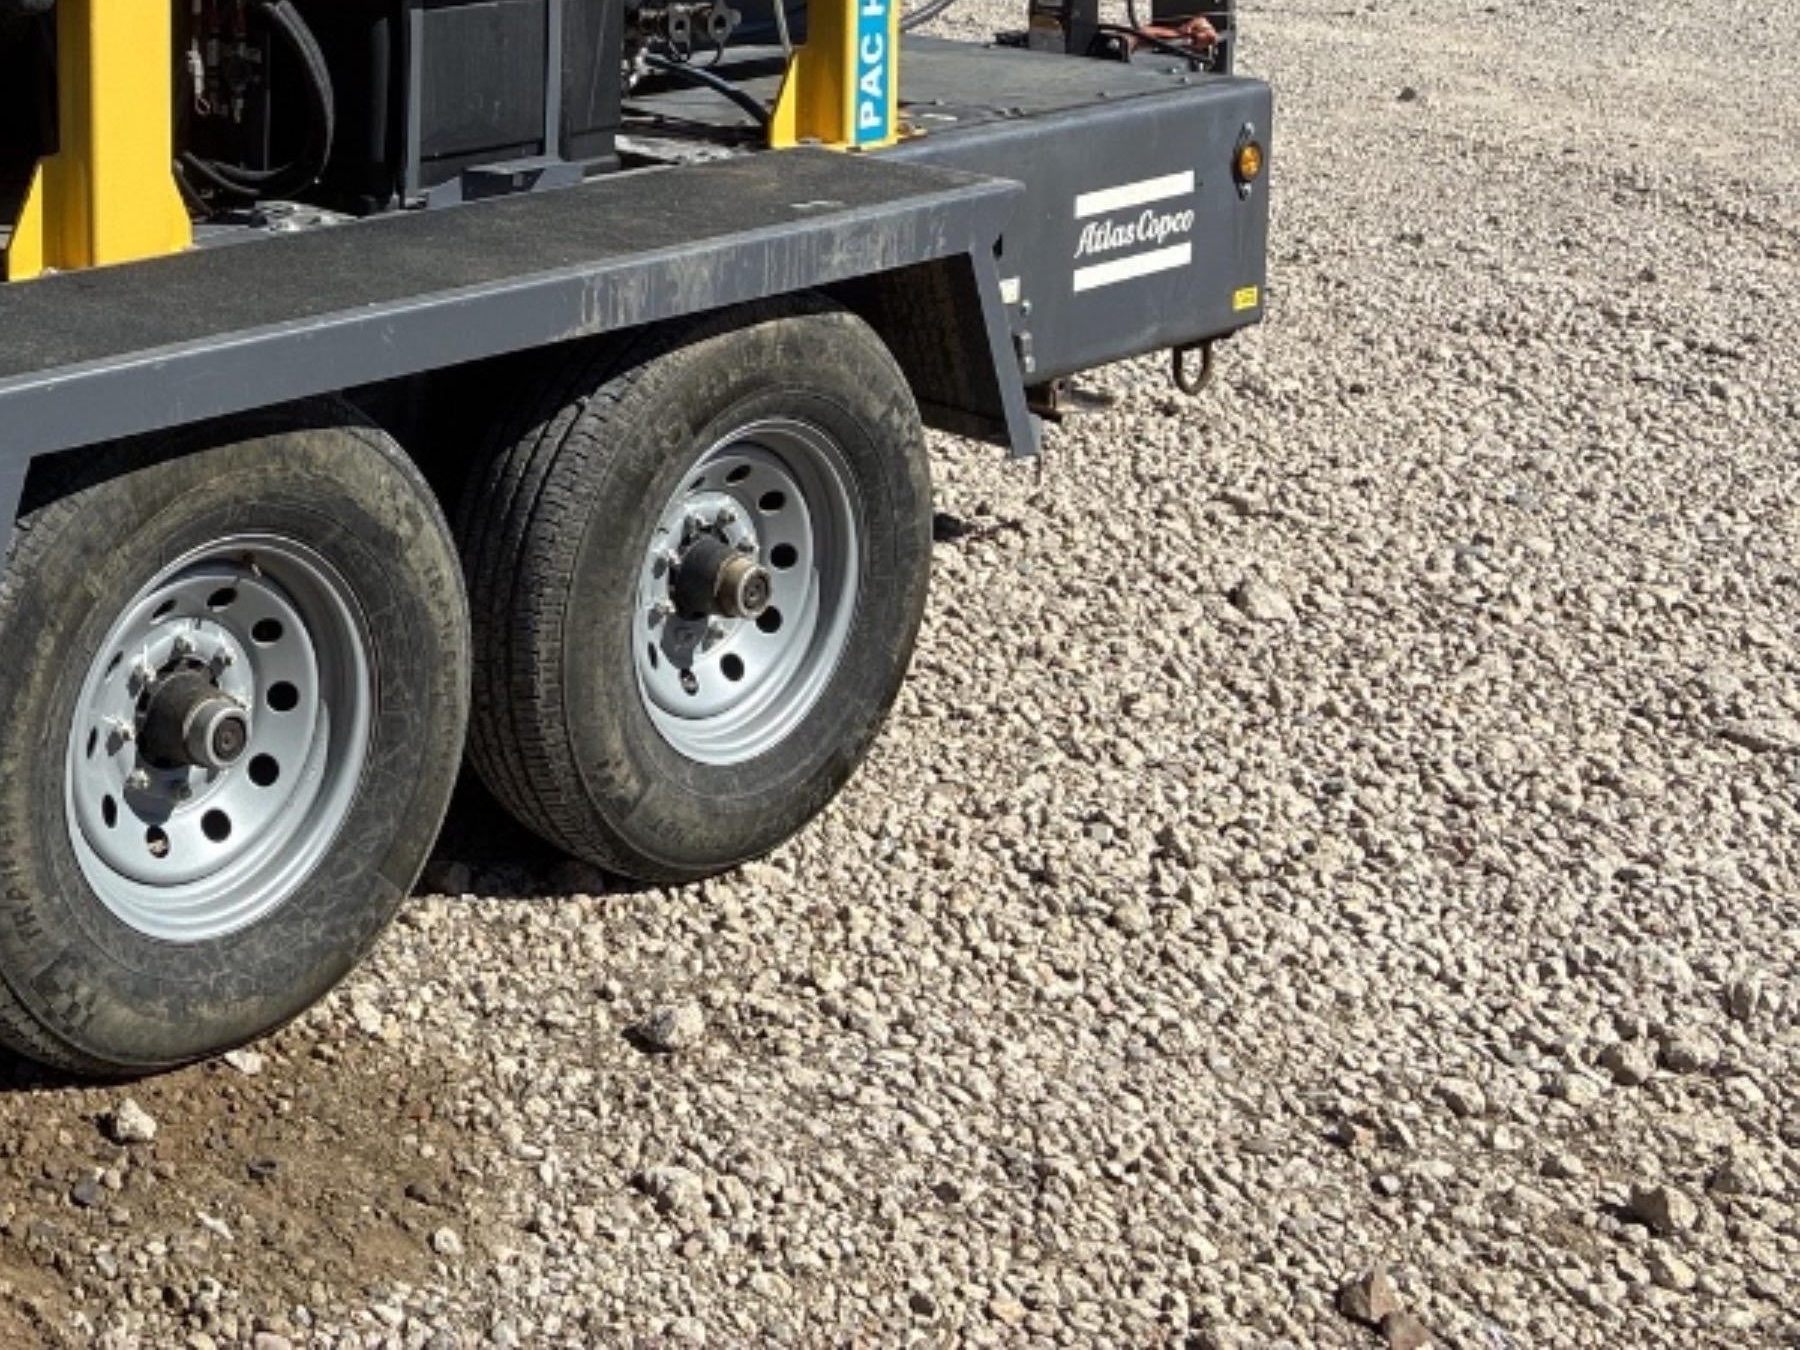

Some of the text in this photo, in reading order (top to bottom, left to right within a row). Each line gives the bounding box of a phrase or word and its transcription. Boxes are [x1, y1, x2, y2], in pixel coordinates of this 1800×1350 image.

[858, 32, 883, 130] PAC
[1073, 209, 1194, 258] Atlas Copco
